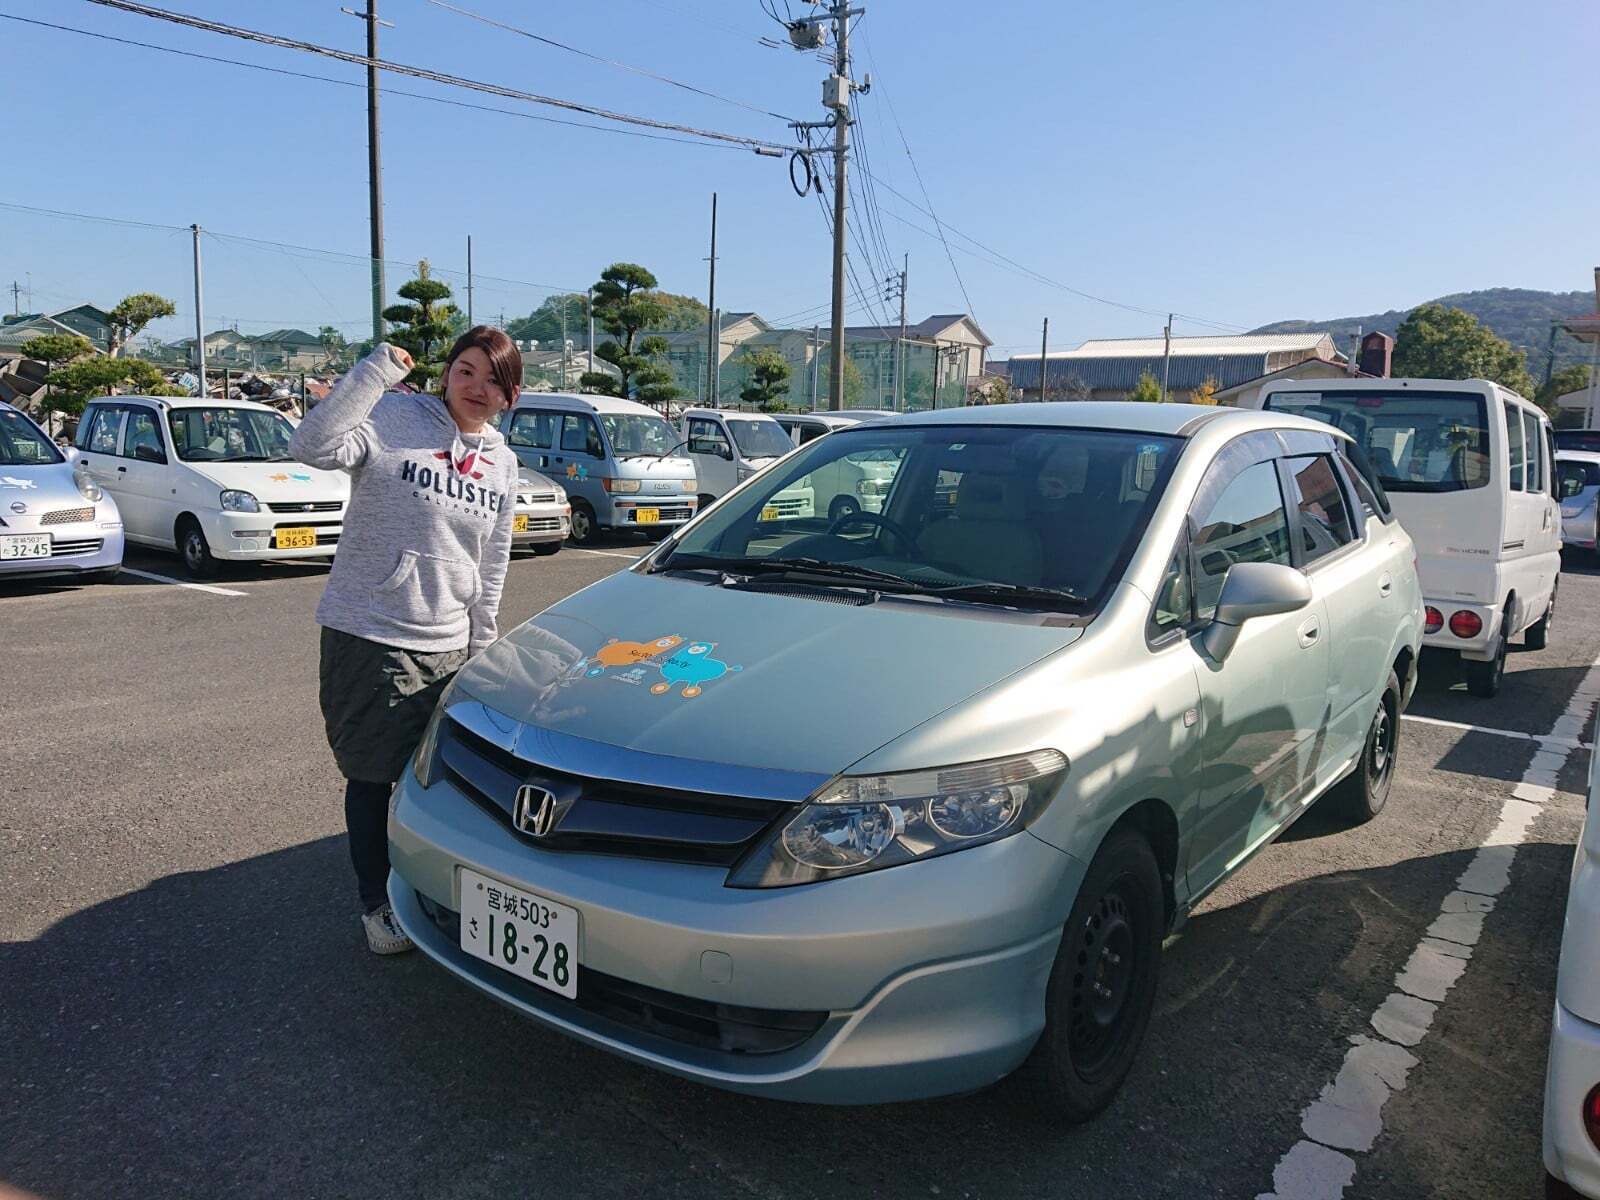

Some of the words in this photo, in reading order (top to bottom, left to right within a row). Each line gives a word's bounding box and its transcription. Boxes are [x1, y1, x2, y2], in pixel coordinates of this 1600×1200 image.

[11, 543, 48, 557] 32-45
[285, 536, 314, 547] 96-53
[486, 887, 550, 929] 宮城503
[469, 917, 478, 939] さ
[488, 914, 570, 988] 18-28
